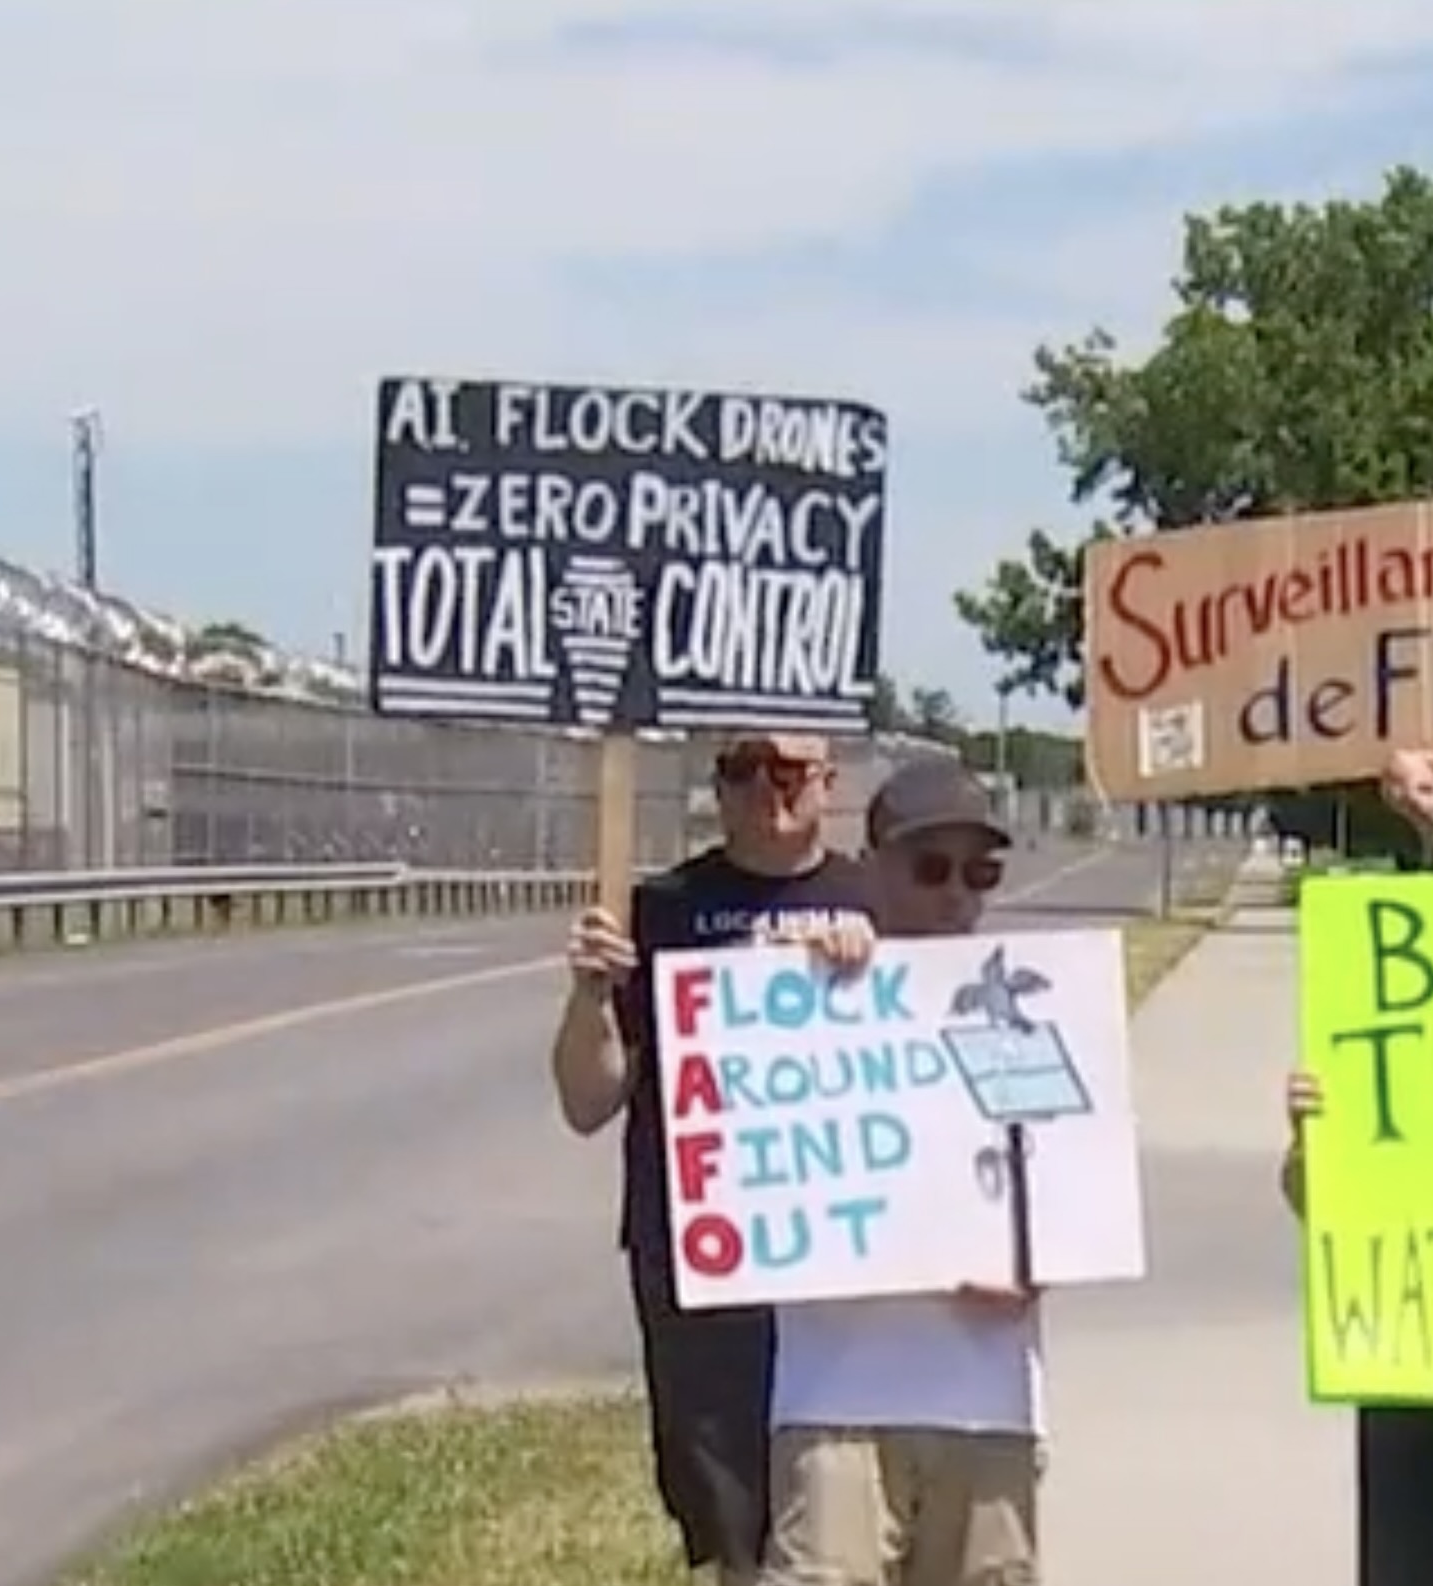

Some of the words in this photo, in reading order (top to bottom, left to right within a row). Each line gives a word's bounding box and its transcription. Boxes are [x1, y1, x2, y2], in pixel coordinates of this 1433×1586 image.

[497, 386, 708, 457] FLOCK
[719, 398, 885, 474] DRONES
[625, 470, 878, 570] PRIVACY
[373, 546, 559, 680] TOTAL
[551, 587, 645, 639] STATE
[652, 560, 876, 698] CONTROL
[672, 962, 912, 1038] FLOCK
[673, 1040, 947, 1120] AROUND
[673, 1112, 912, 1204] FIND
[681, 1198, 889, 1278] OUT
